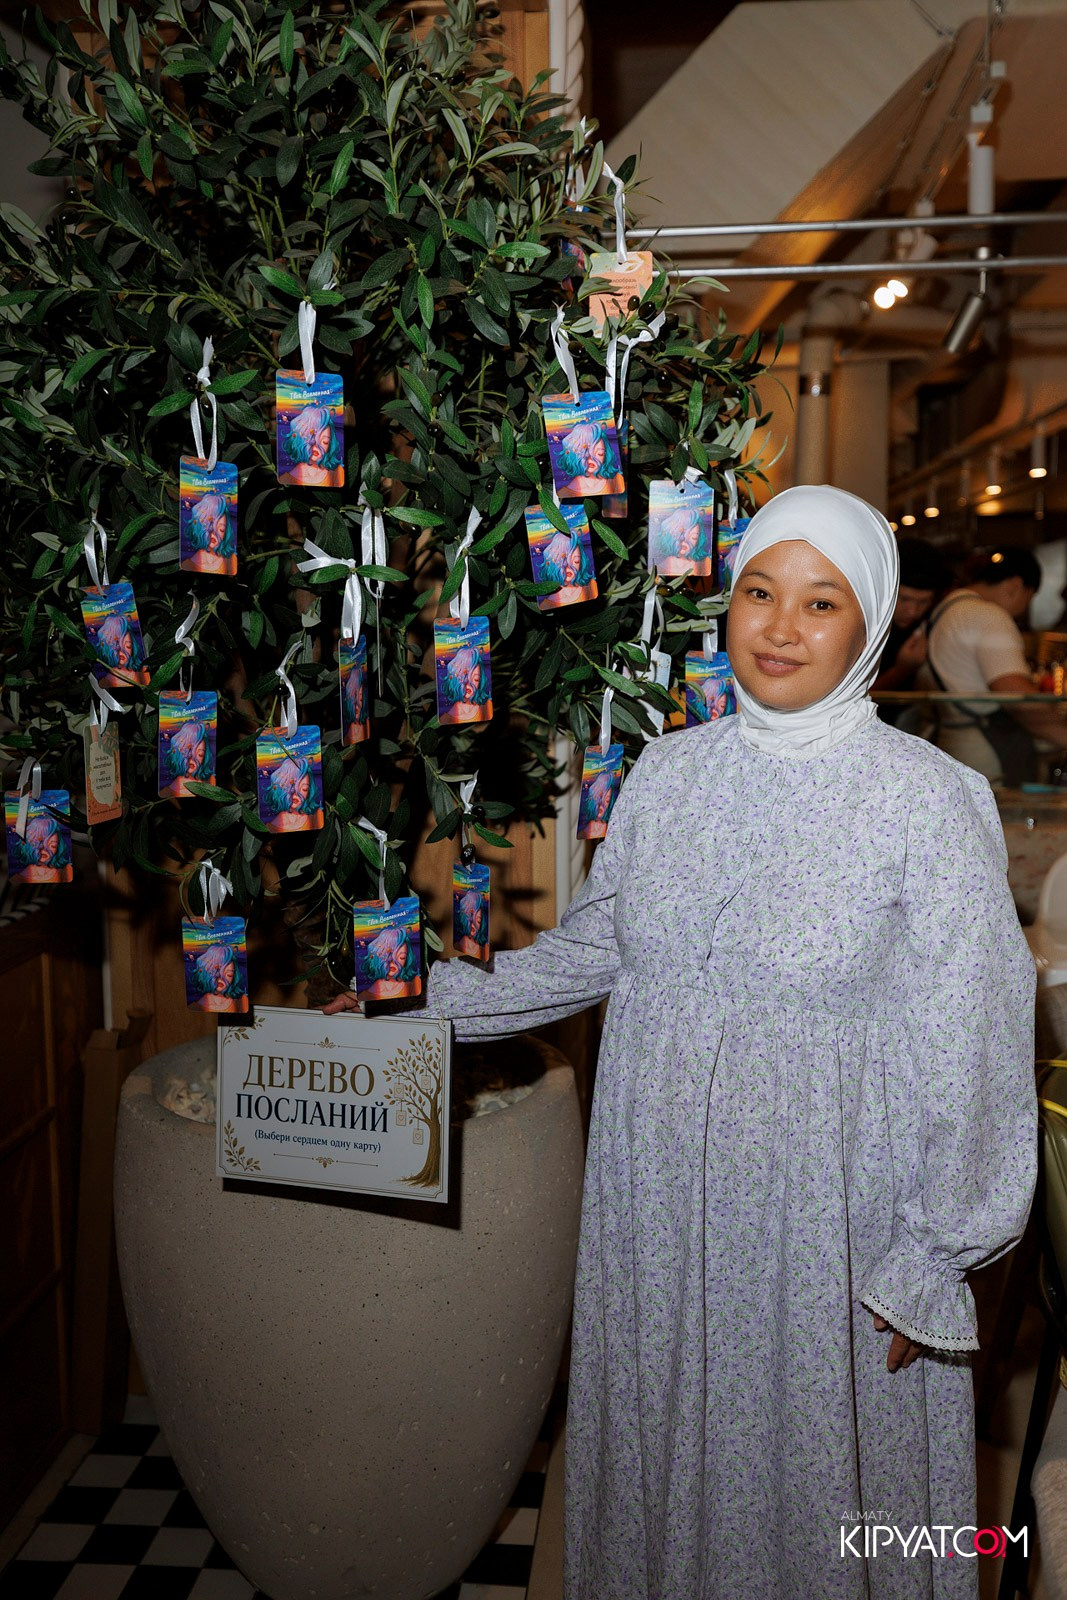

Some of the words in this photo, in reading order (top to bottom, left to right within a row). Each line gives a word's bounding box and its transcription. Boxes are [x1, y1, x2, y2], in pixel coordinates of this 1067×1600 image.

[242, 1054, 375, 1097] ДЕРЕВО
[235, 1093, 389, 1133] ПОСЛАНИЙ
[254, 1128, 291, 1142] (Выбери
[292, 1135, 328, 1147] сердцем
[330, 1138, 351, 1149] одну
[353, 1141, 381, 1153] карту)
